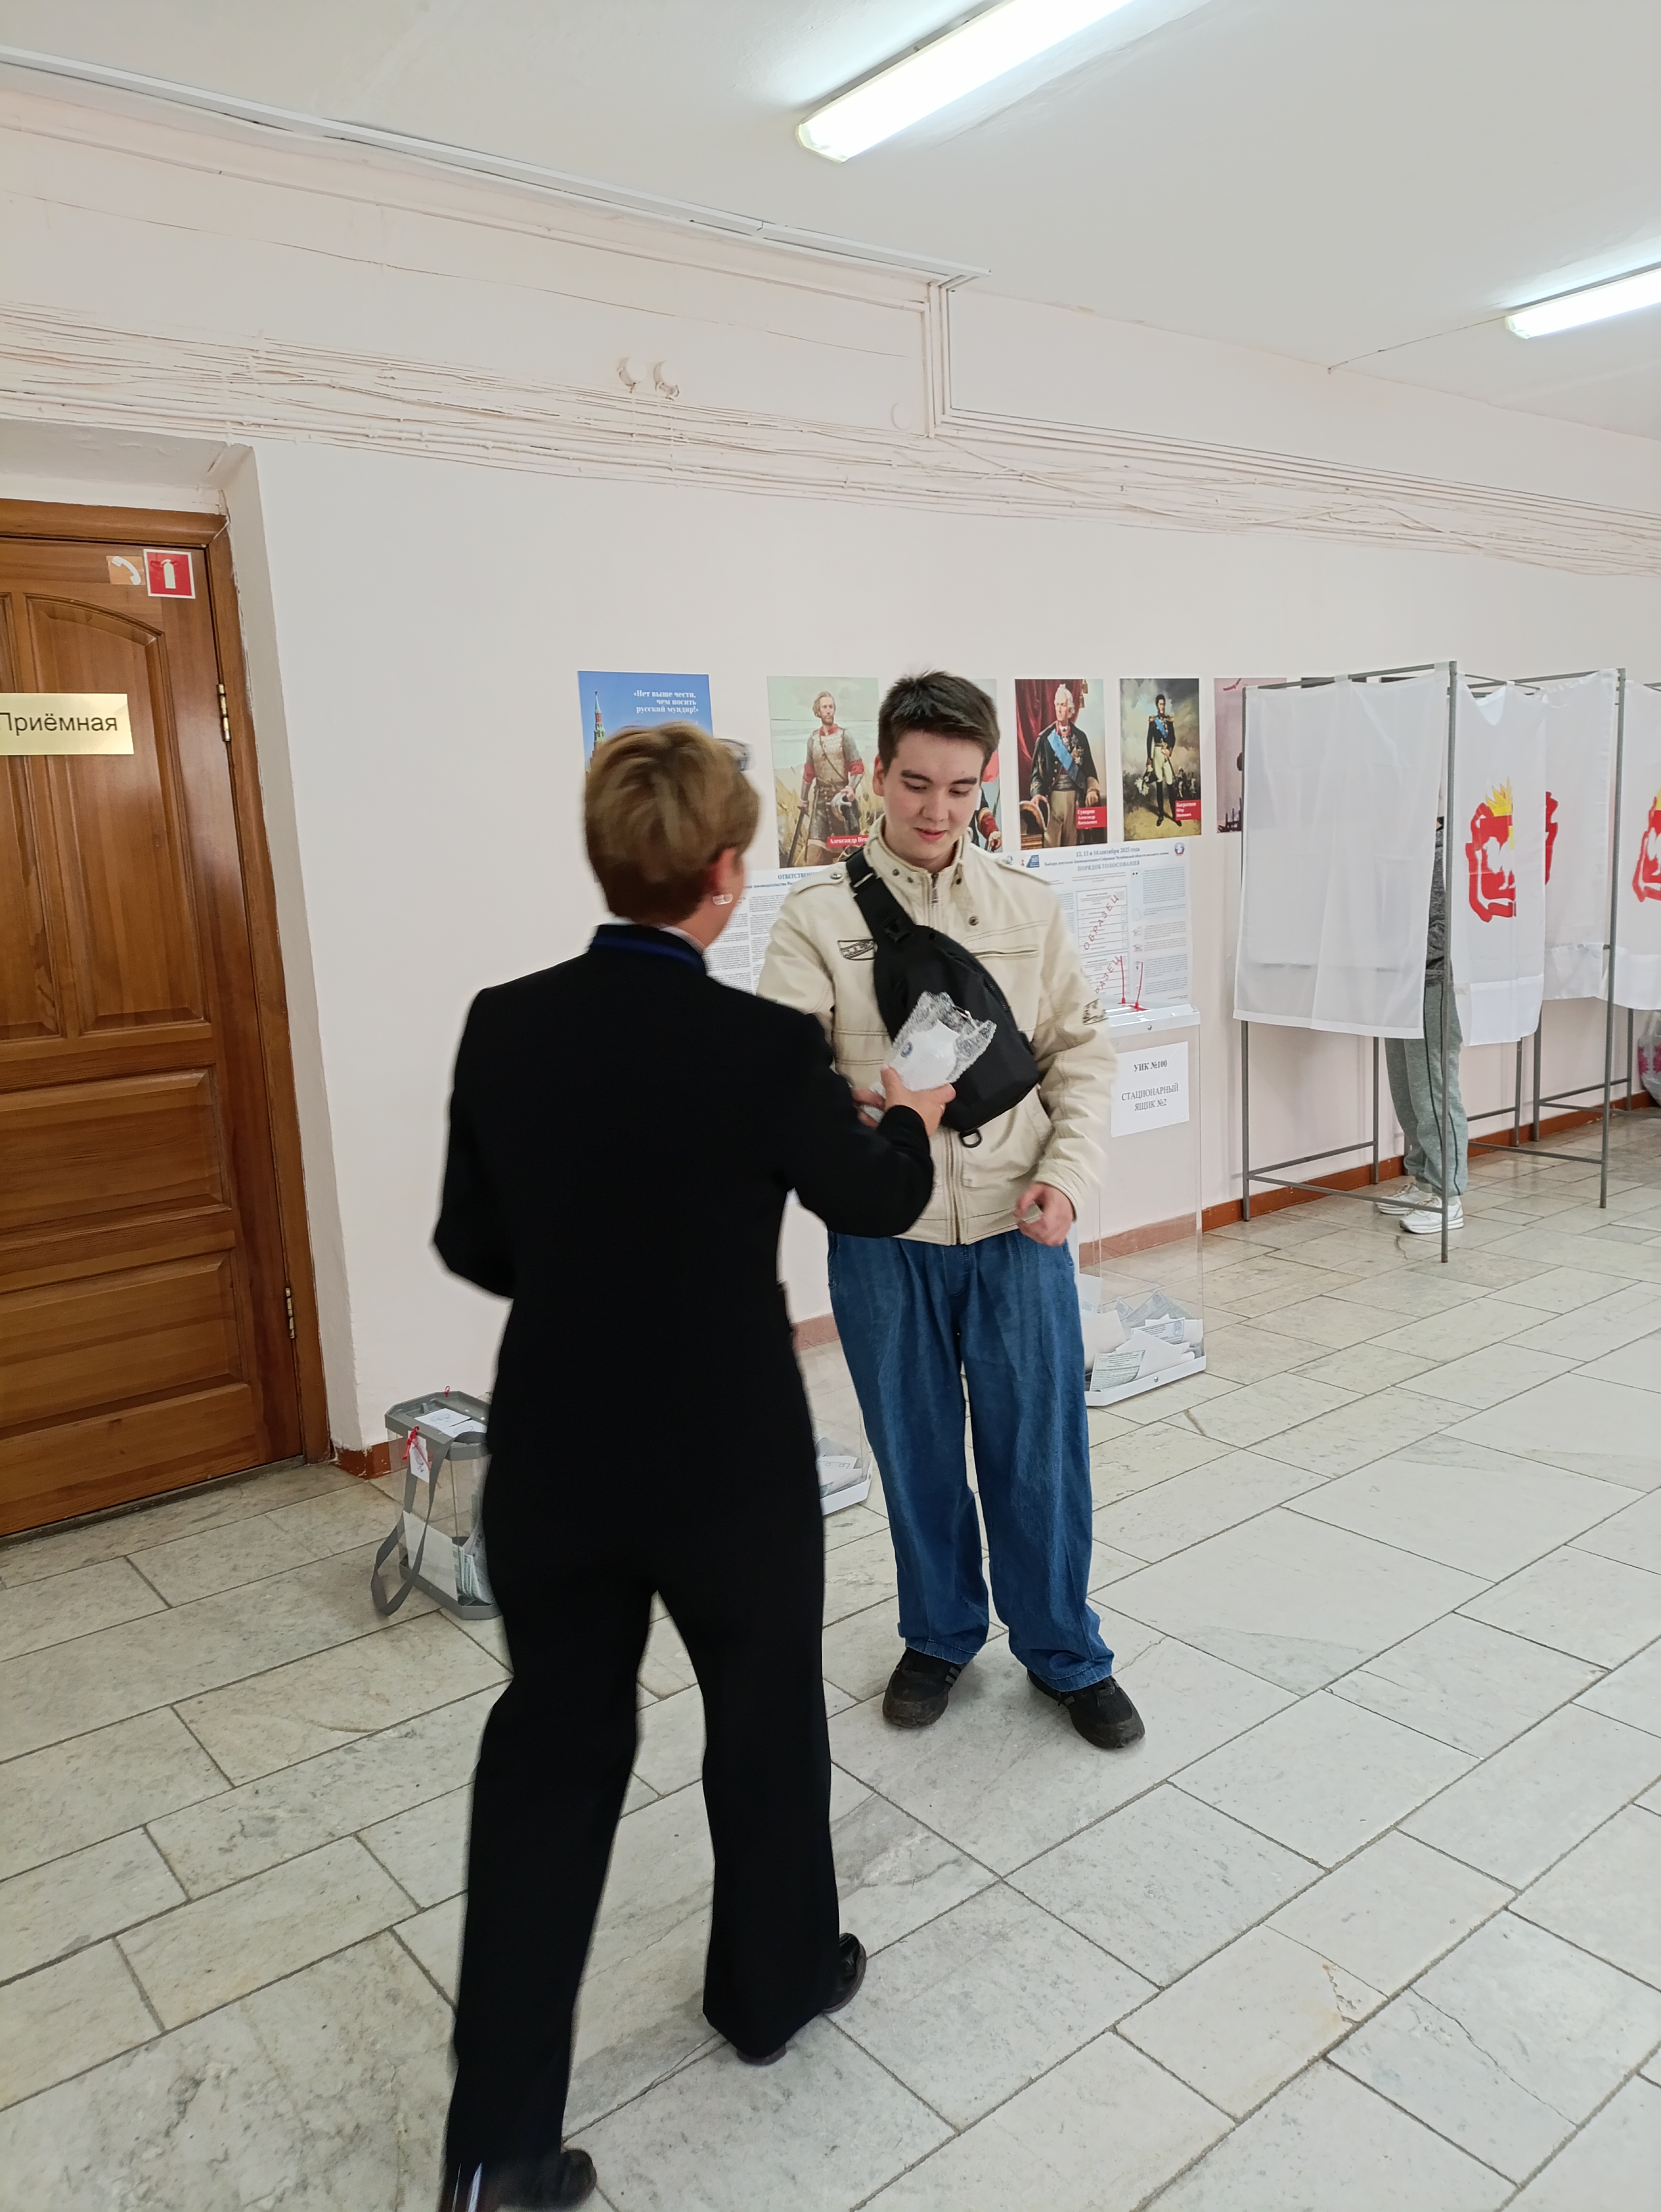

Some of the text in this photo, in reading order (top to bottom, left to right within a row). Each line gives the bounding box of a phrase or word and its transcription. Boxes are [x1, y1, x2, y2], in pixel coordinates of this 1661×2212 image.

[636, 706, 665, 714] русский
[0, 712, 117, 736] Приёмная
[1102, 860, 1140, 869] ГОЛОСОВАНИЯ
[1084, 895, 1119, 950] ОБРАЗЕЦ
[1134, 1060, 1167, 1072] УИК №100
[1121, 1083, 1179, 1101] СТАЦИОНАРНЫЙ
[1134, 1099, 1167, 1111] ЯЩИК №2
